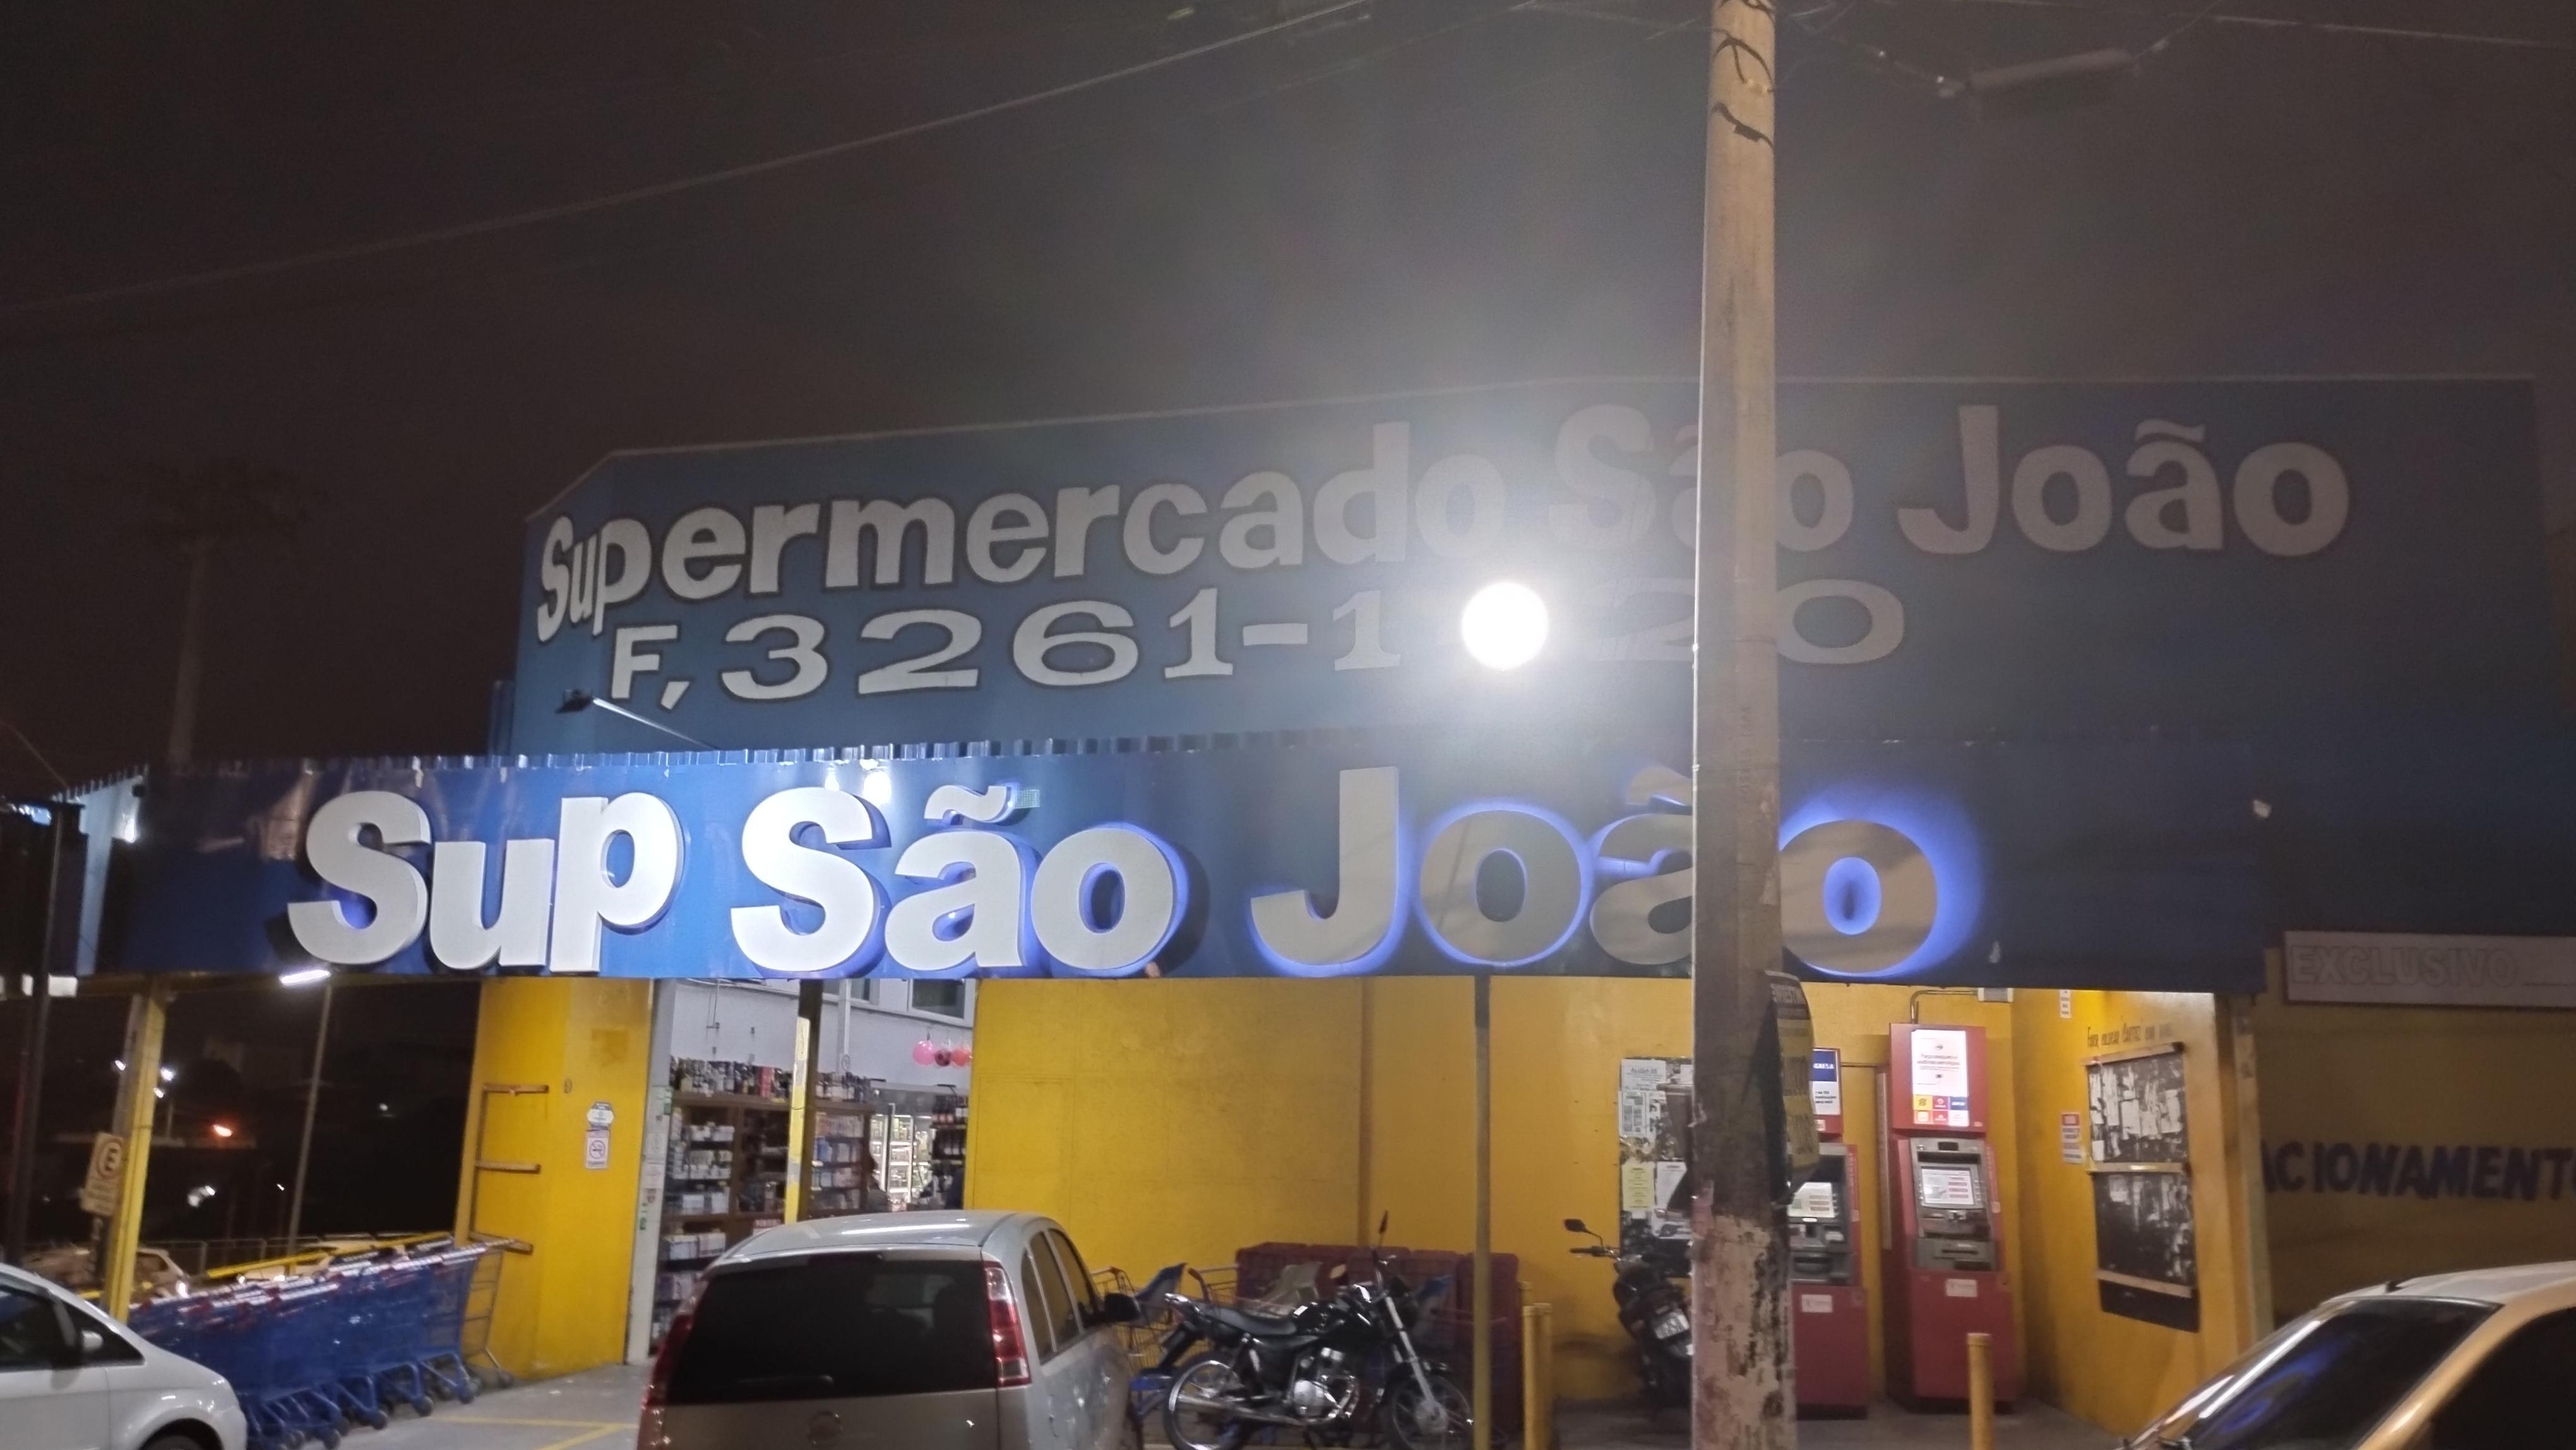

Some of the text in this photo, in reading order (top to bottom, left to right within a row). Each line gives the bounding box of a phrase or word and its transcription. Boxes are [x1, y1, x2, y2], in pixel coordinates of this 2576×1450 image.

[537, 421, 1506, 644] Supermercado
[1897, 404, 2350, 557] João
[721, 578, 1905, 700] 3261-120
[287, 791, 685, 974] Sup
[731, 784, 1178, 974] São
[2290, 945, 2517, 987] EXCLUSIVO
[2260, 1140, 2576, 1201] CIONAMENT
